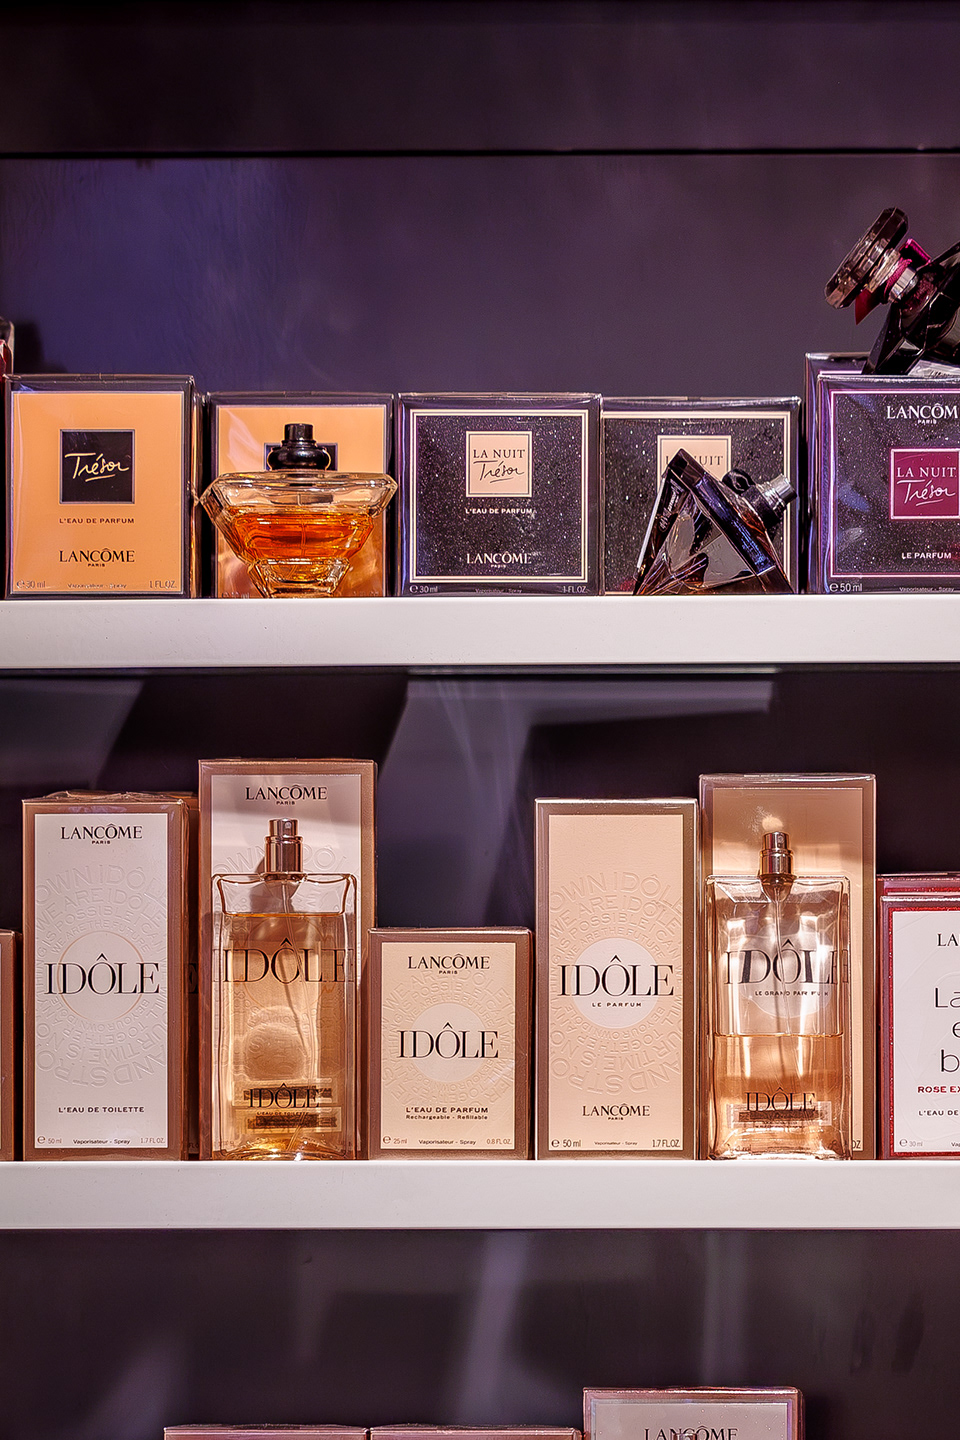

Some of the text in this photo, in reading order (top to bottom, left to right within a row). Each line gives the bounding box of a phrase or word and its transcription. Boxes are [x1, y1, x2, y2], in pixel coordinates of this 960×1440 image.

[473, 449, 525, 458] LA NUIT
[65, 452, 130, 477] Trésor
[473, 460, 525, 480] Trésor
[896, 467, 956, 478] LA NUIT
[897, 480, 955, 502] Trésor
[59, 547, 135, 563] LANCÔME
[466, 550, 532, 564] LANCÔME
[245, 785, 327, 801] LANCÔME
[60, 824, 143, 840] LANCÔME
[407, 954, 490, 969] LANCÔME
[44, 953, 160, 995] IDÔLE
[557, 955, 674, 996] IDÔLE
[397, 1022, 498, 1059] IDÔLE
[582, 1104, 650, 1117] LANCÔME
